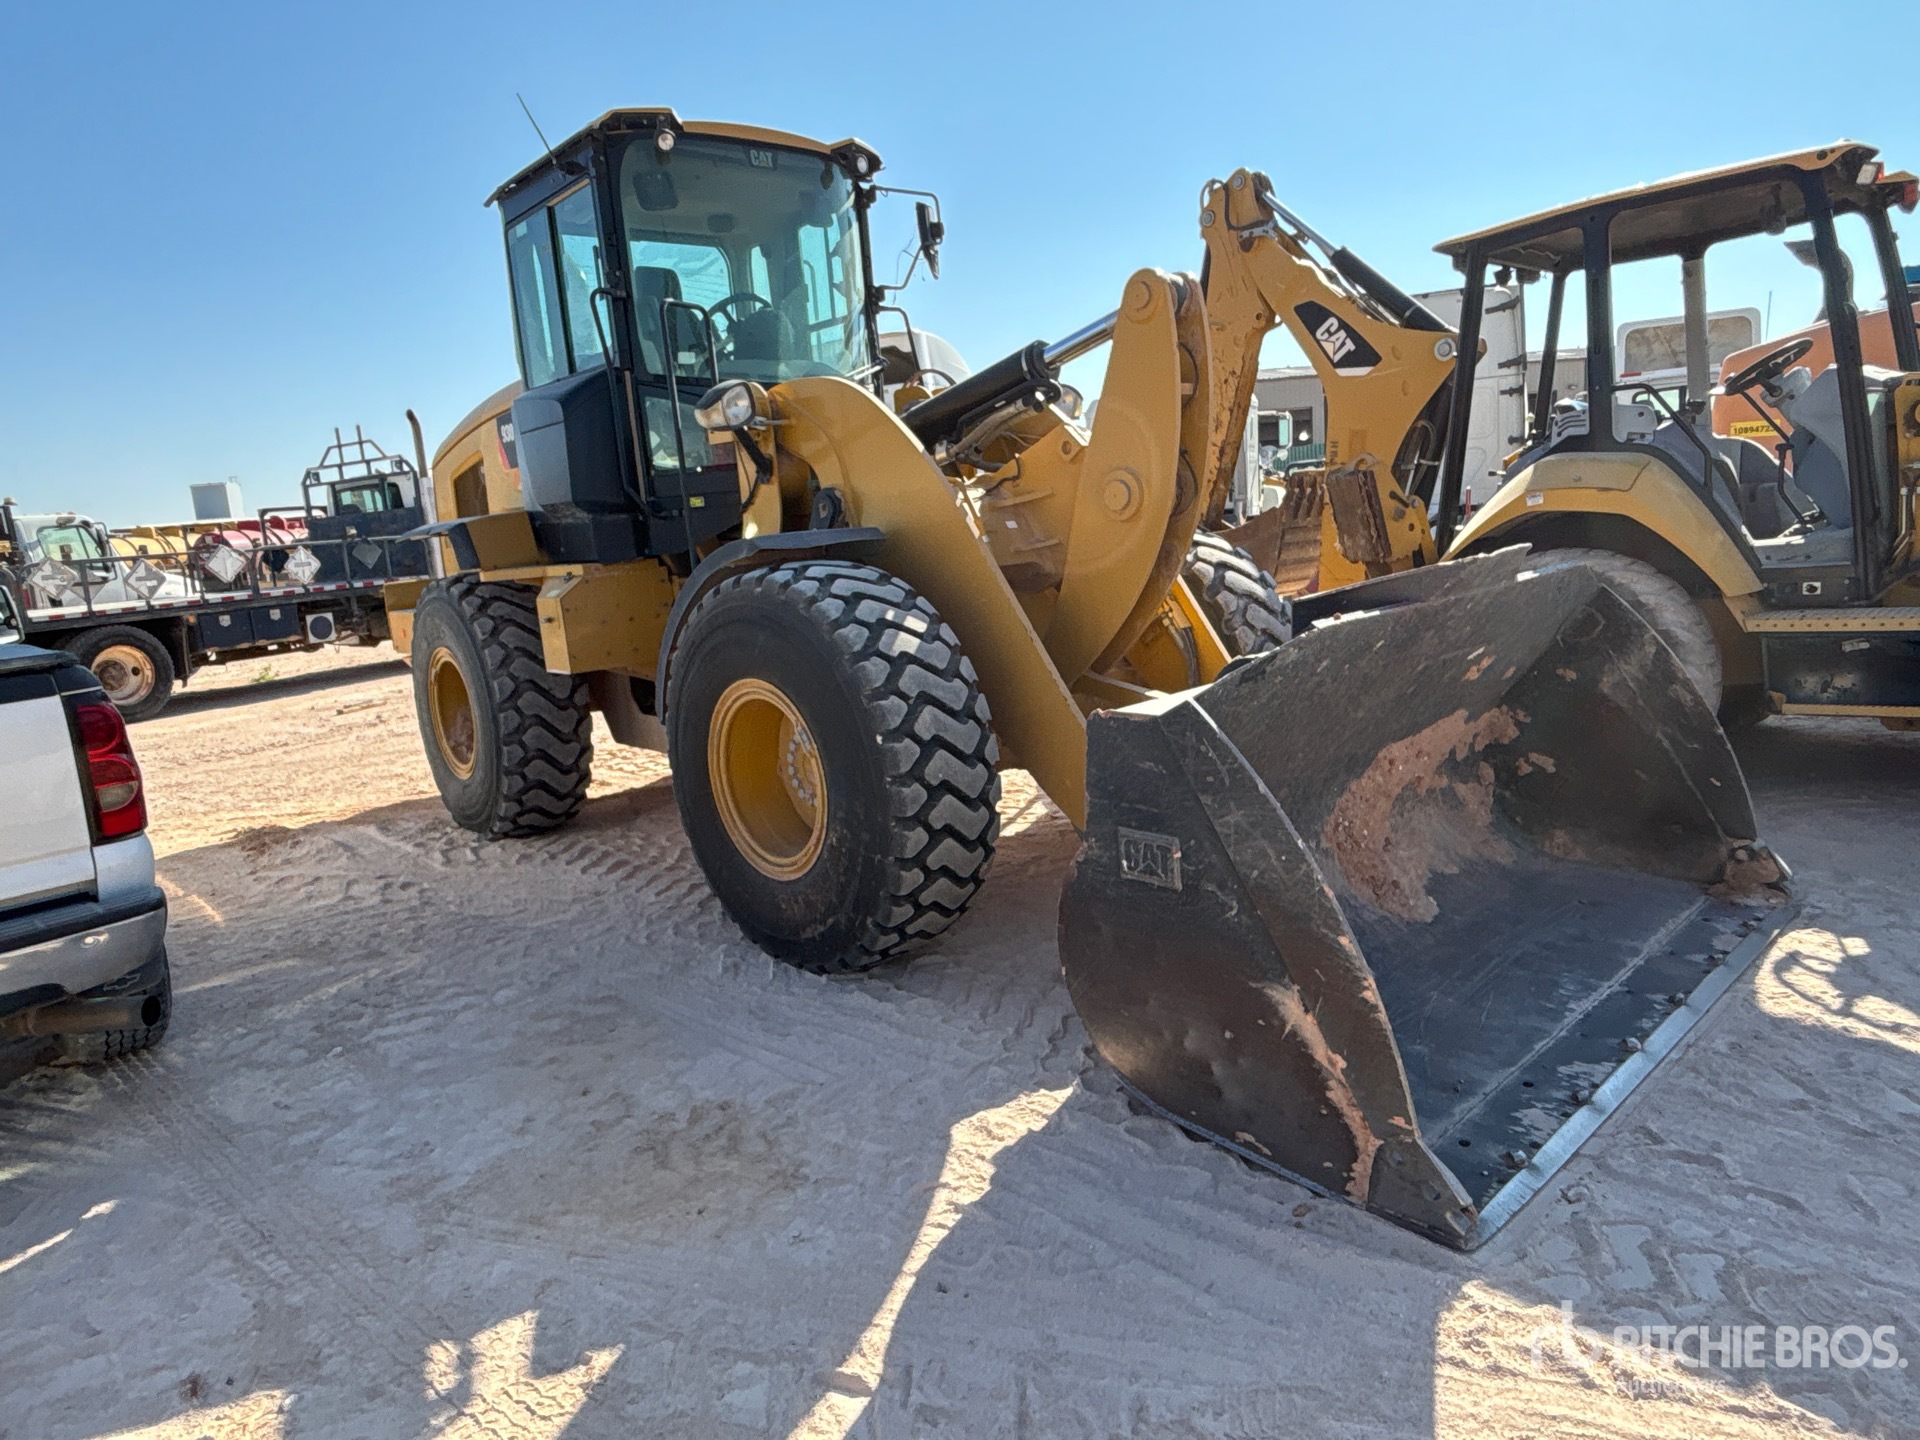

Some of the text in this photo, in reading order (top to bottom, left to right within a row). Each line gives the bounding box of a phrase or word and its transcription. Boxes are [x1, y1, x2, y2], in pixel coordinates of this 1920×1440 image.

[750, 149, 773, 168] CAT
[1315, 316, 1356, 363] CAT
[1121, 837, 1175, 882] CAT
